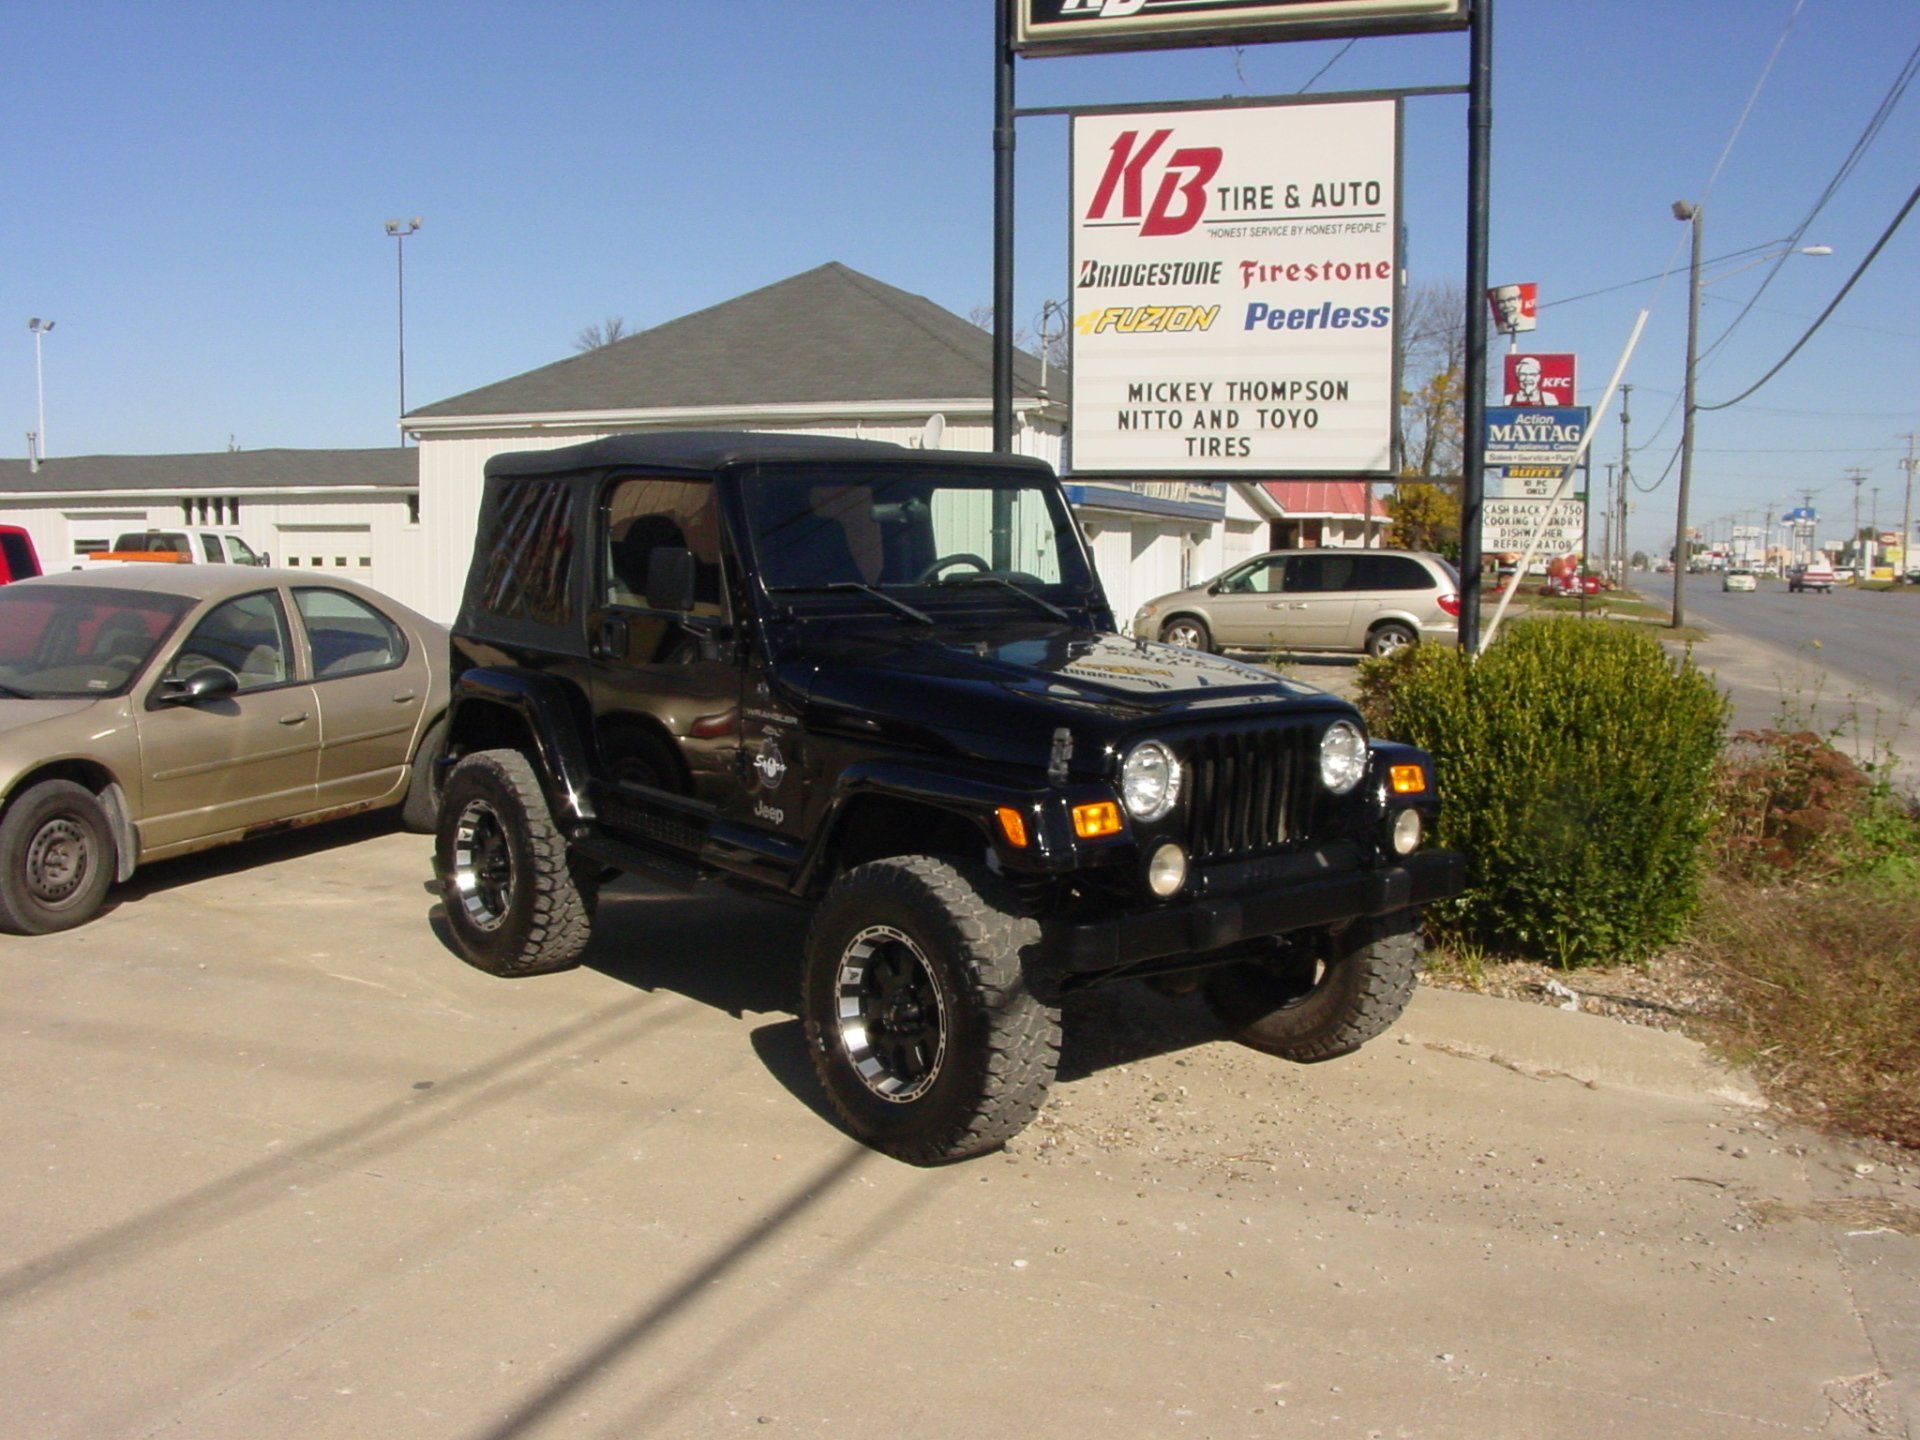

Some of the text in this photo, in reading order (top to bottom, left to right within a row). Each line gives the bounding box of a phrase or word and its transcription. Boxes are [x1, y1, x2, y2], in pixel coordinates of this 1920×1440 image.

[1085, 128, 1224, 237] KB
[1217, 180, 1382, 212] TIRE & AUTO
[1250, 225, 1288, 238] SERVICE
[1290, 224, 1303, 237] BY
[1304, 223, 1342, 236] HONEST
[1078, 260, 1223, 289] BRIDGESTONE
[1238, 260, 1391, 290] Firestone
[1094, 304, 1221, 334] FUZION
[1244, 301, 1390, 331] Peerless
[1128, 380, 1349, 403] MICKEY THOMPSON
[1542, 378, 1571, 387] KFC
[1118, 408, 1319, 431] NITTO AND TOYO
[1515, 414, 1554, 424] Action
[1489, 425, 1580, 442] MAYTAG
[1186, 436, 1251, 457] TIRES
[1517, 453, 1550, 462] Service
[1509, 468, 1562, 477] BUFFET
[1484, 504, 1510, 515] CASH
[1513, 505, 1540, 515] BACK
[1563, 504, 1582, 516] 750
[1484, 516, 1529, 526] COOKING
[1493, 539, 1572, 550] REFRIGRATOR
[754, 800, 785, 825] Jeep
